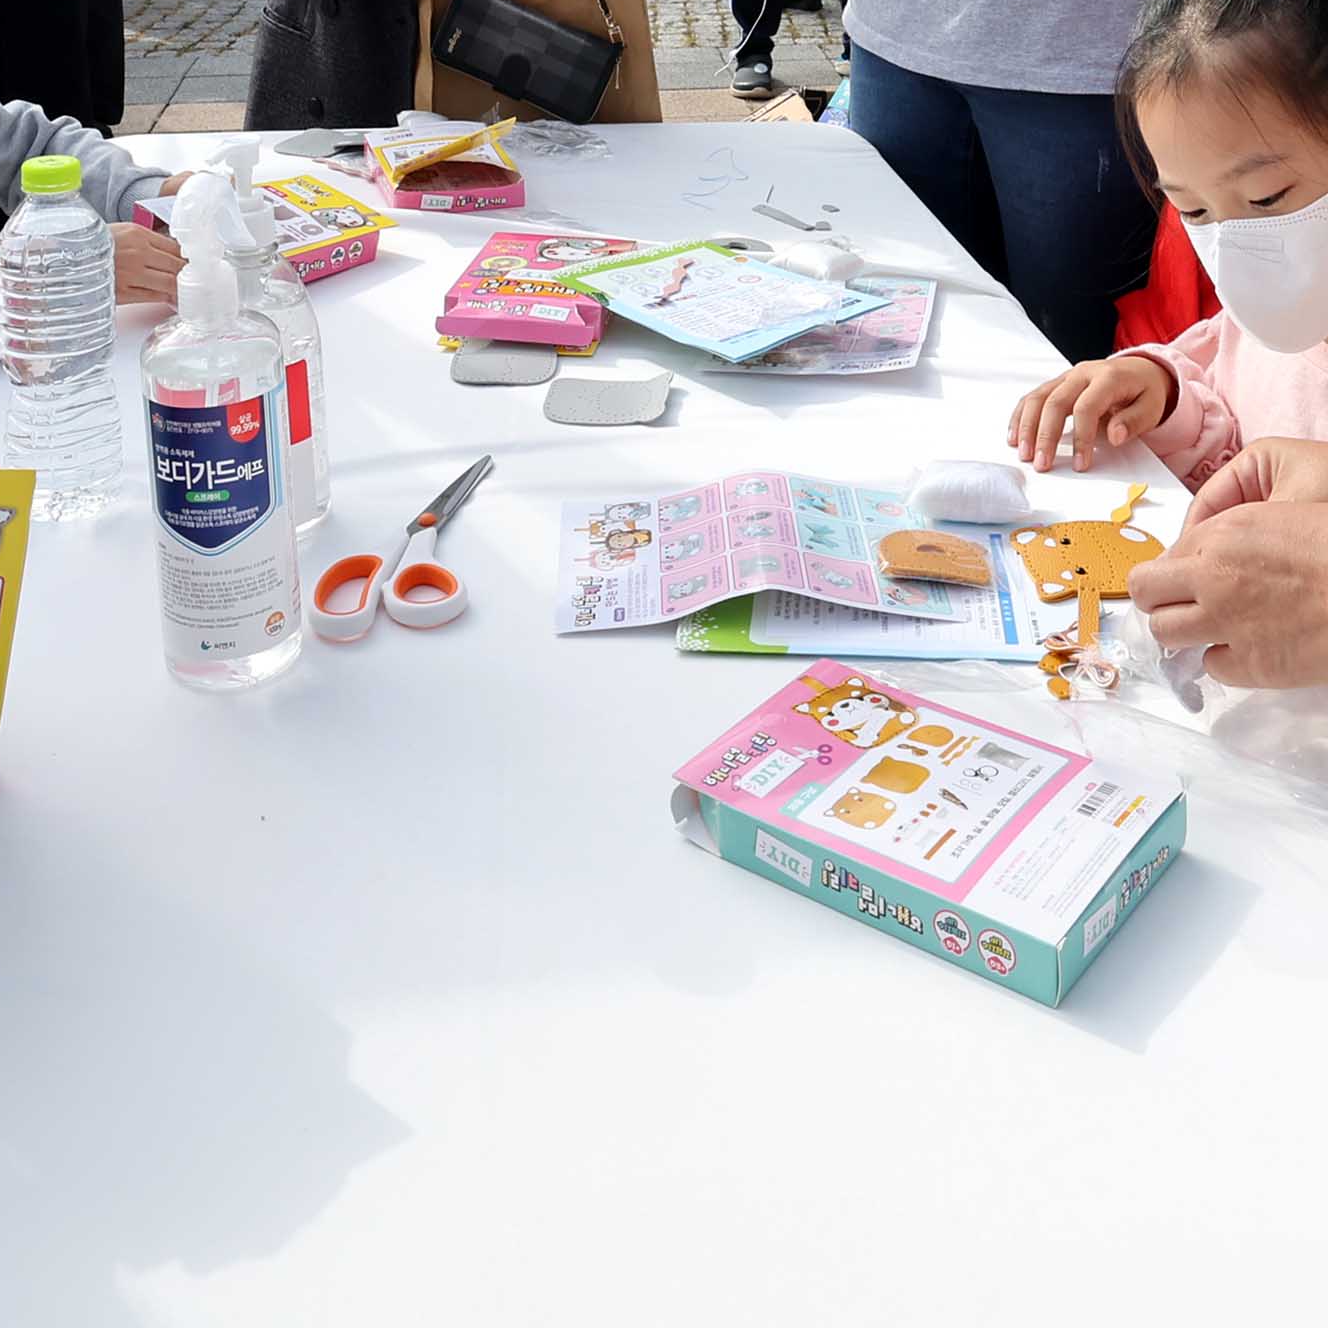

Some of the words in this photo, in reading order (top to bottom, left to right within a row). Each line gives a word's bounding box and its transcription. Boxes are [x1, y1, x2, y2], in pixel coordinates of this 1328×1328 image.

[239, 412, 253, 424] 살균
[230, 422, 260, 435] 99.99%
[750, 759, 786, 787] DIY
[765, 845, 801, 876] DIY
